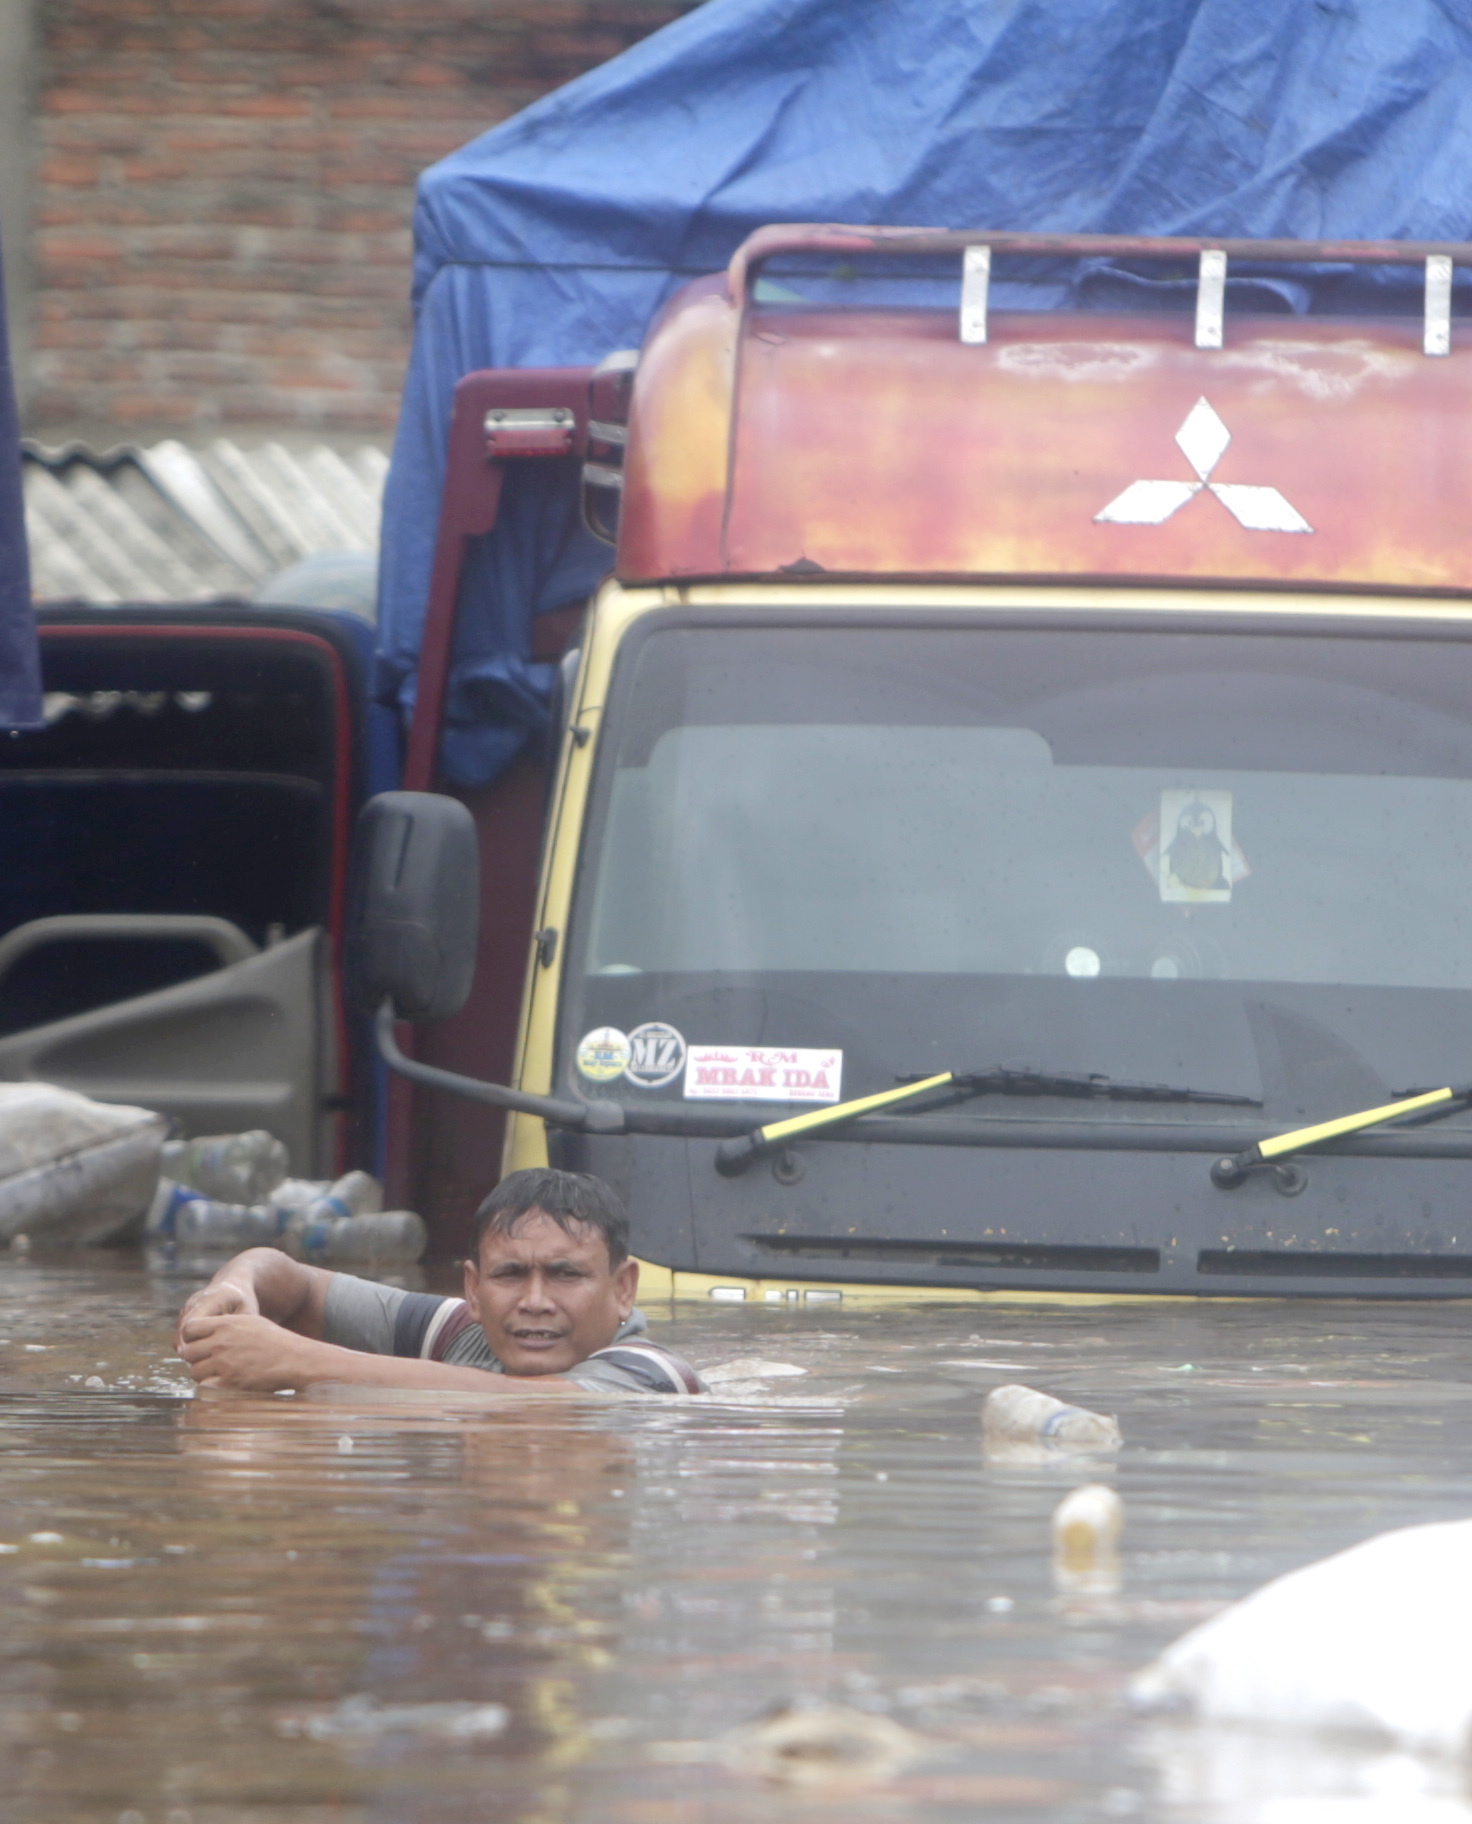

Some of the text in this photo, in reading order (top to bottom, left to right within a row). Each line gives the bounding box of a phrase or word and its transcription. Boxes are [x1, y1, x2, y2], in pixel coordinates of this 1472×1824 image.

[631, 1038, 678, 1066] MZ
[695, 1066, 831, 1089] MBAK IDA
